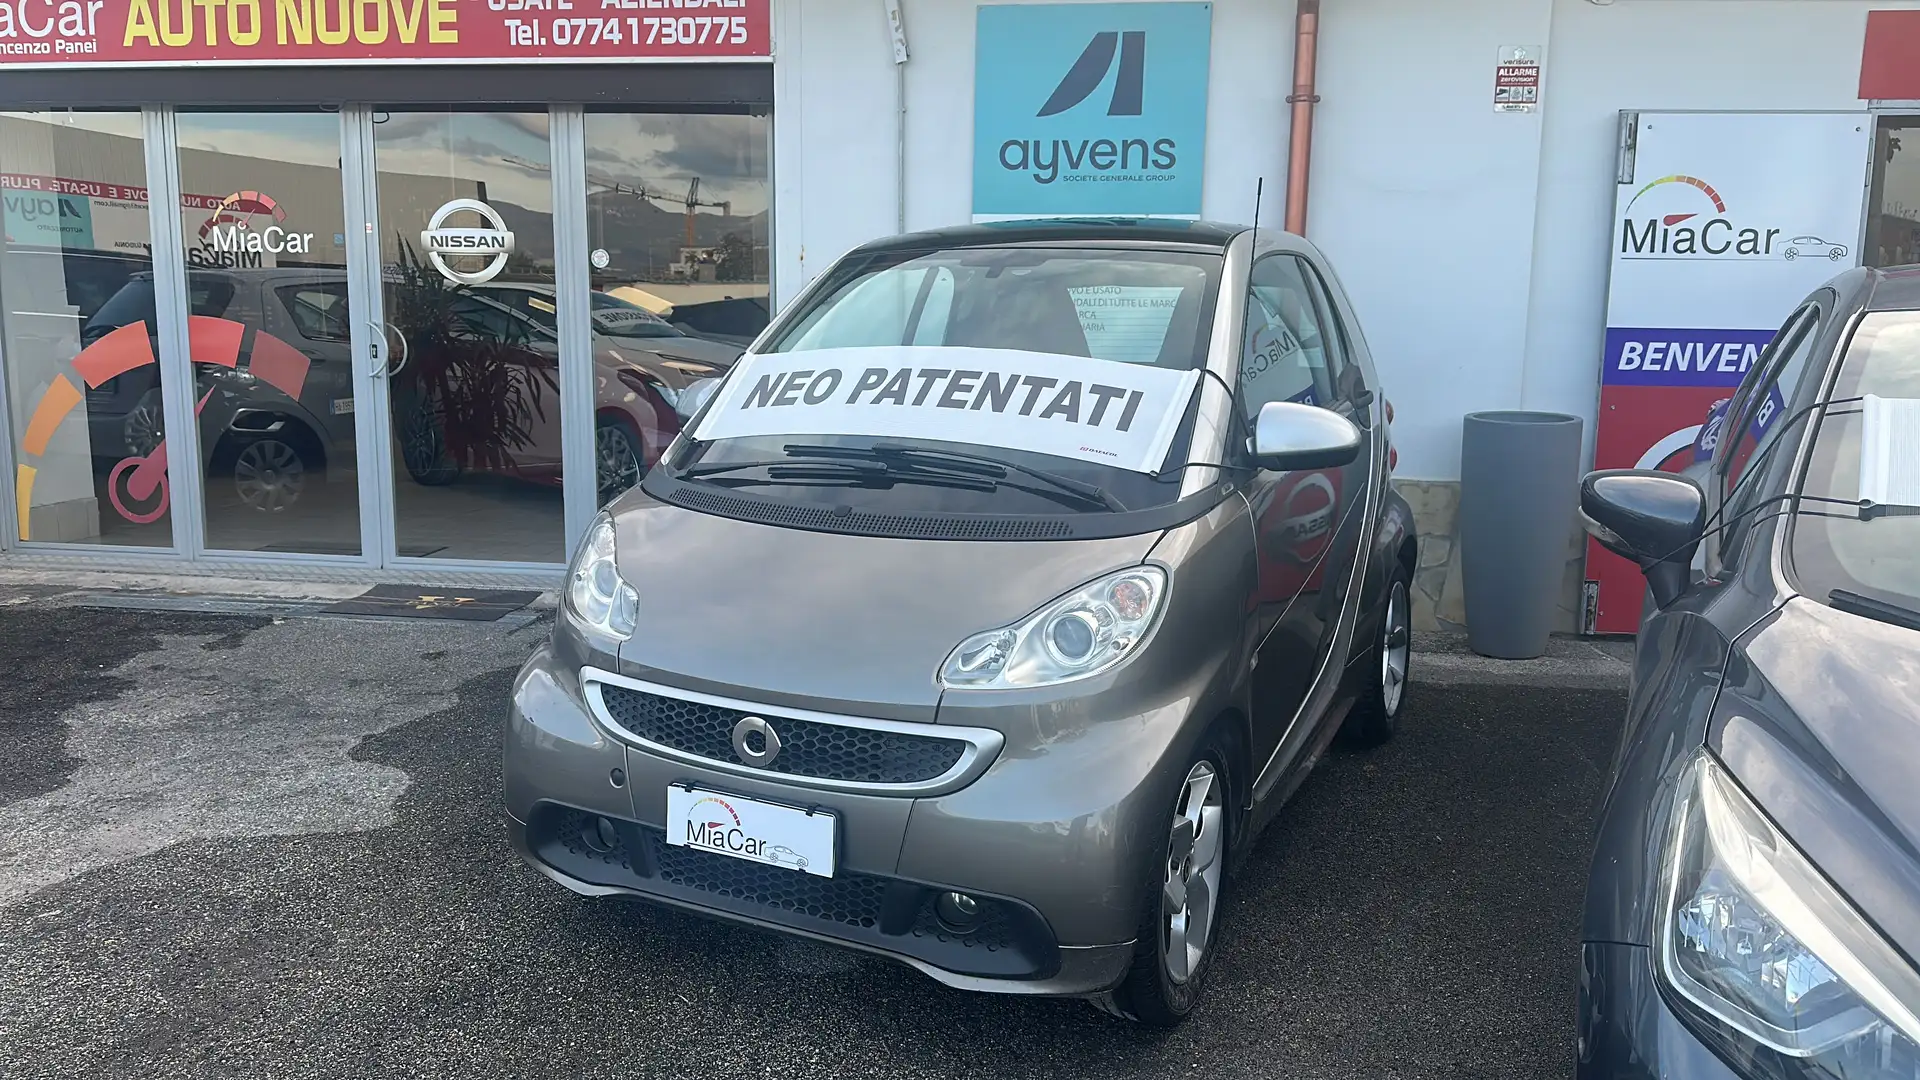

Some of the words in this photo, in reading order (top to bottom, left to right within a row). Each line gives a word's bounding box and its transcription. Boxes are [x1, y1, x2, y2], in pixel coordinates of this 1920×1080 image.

[122, 0, 262, 47] AUTO
[276, 0, 460, 45] NUOVE
[504, 18, 547, 46] Tel.
[55, 38, 97, 54] Panei
[1498, 68, 1537, 76] ALLARME
[999, 138, 1177, 184] ayvens
[1099, 174, 1144, 182] GENERALE
[212, 220, 314, 254] MiaCar
[430, 235, 505, 248] NISSAN
[1621, 214, 1780, 255] MiaCar
[1138, 300, 1148, 308] LE
[741, 368, 843, 410] NEO
[845, 367, 1144, 433] PATENTATI
[686, 820, 767, 856] MiaCar
